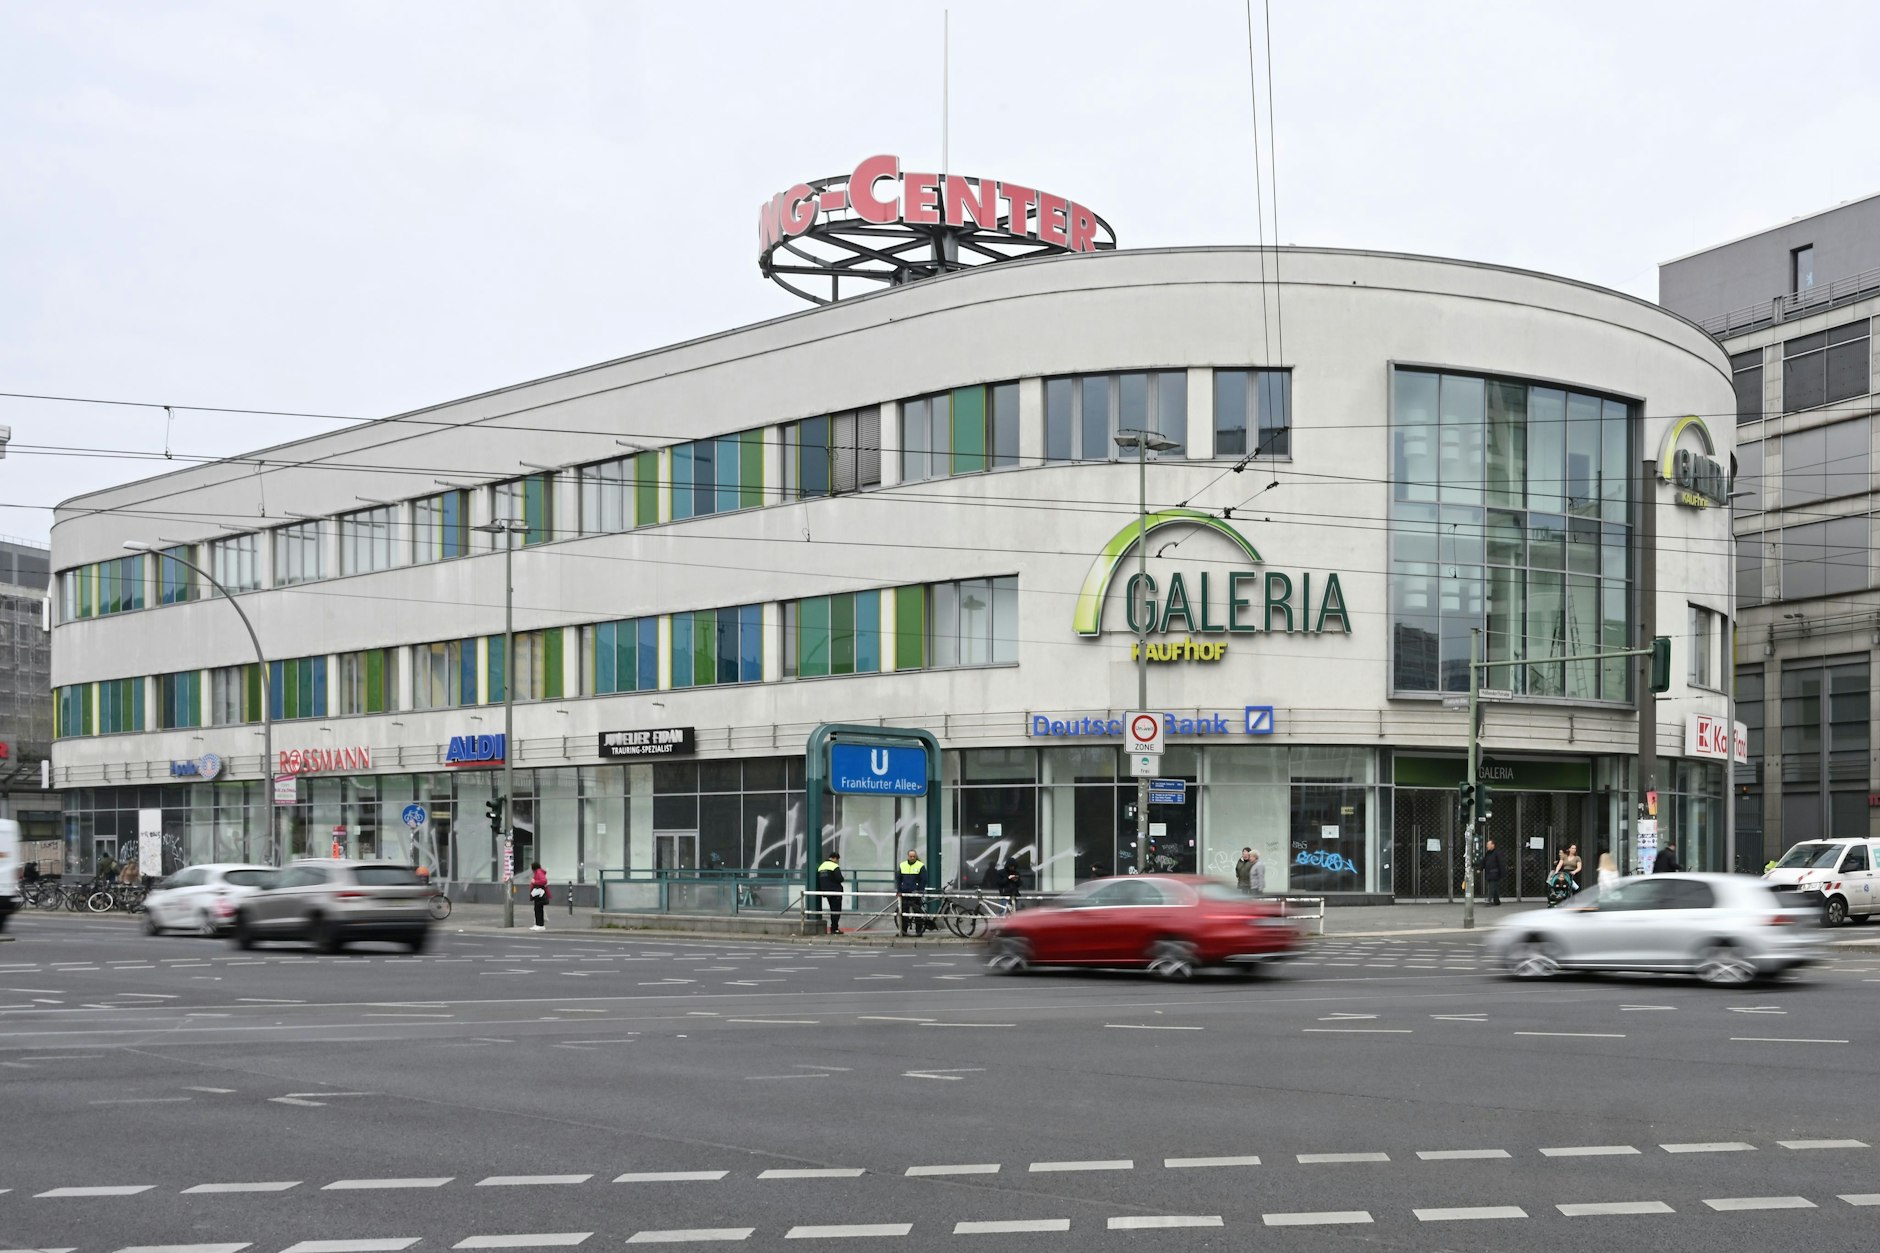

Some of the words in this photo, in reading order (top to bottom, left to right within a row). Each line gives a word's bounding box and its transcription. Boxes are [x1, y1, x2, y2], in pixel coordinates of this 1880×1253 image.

[1126, 571, 1352, 634] GALERIA
[1033, 714, 1125, 737] Deutsc
[1164, 712, 1229, 736] Bank
[446, 733, 506, 761] ALDI
[611, 744, 674, 755] TRAURING-SPEZIALIST
[1135, 743, 1155, 751] ZONE
[279, 746, 372, 774] ROSSMANN
[871, 748, 889, 776] U
[841, 776, 892, 790] Frankfurter
[894, 776, 916, 791] Allee
[1478, 766, 1514, 780] GALERIA
